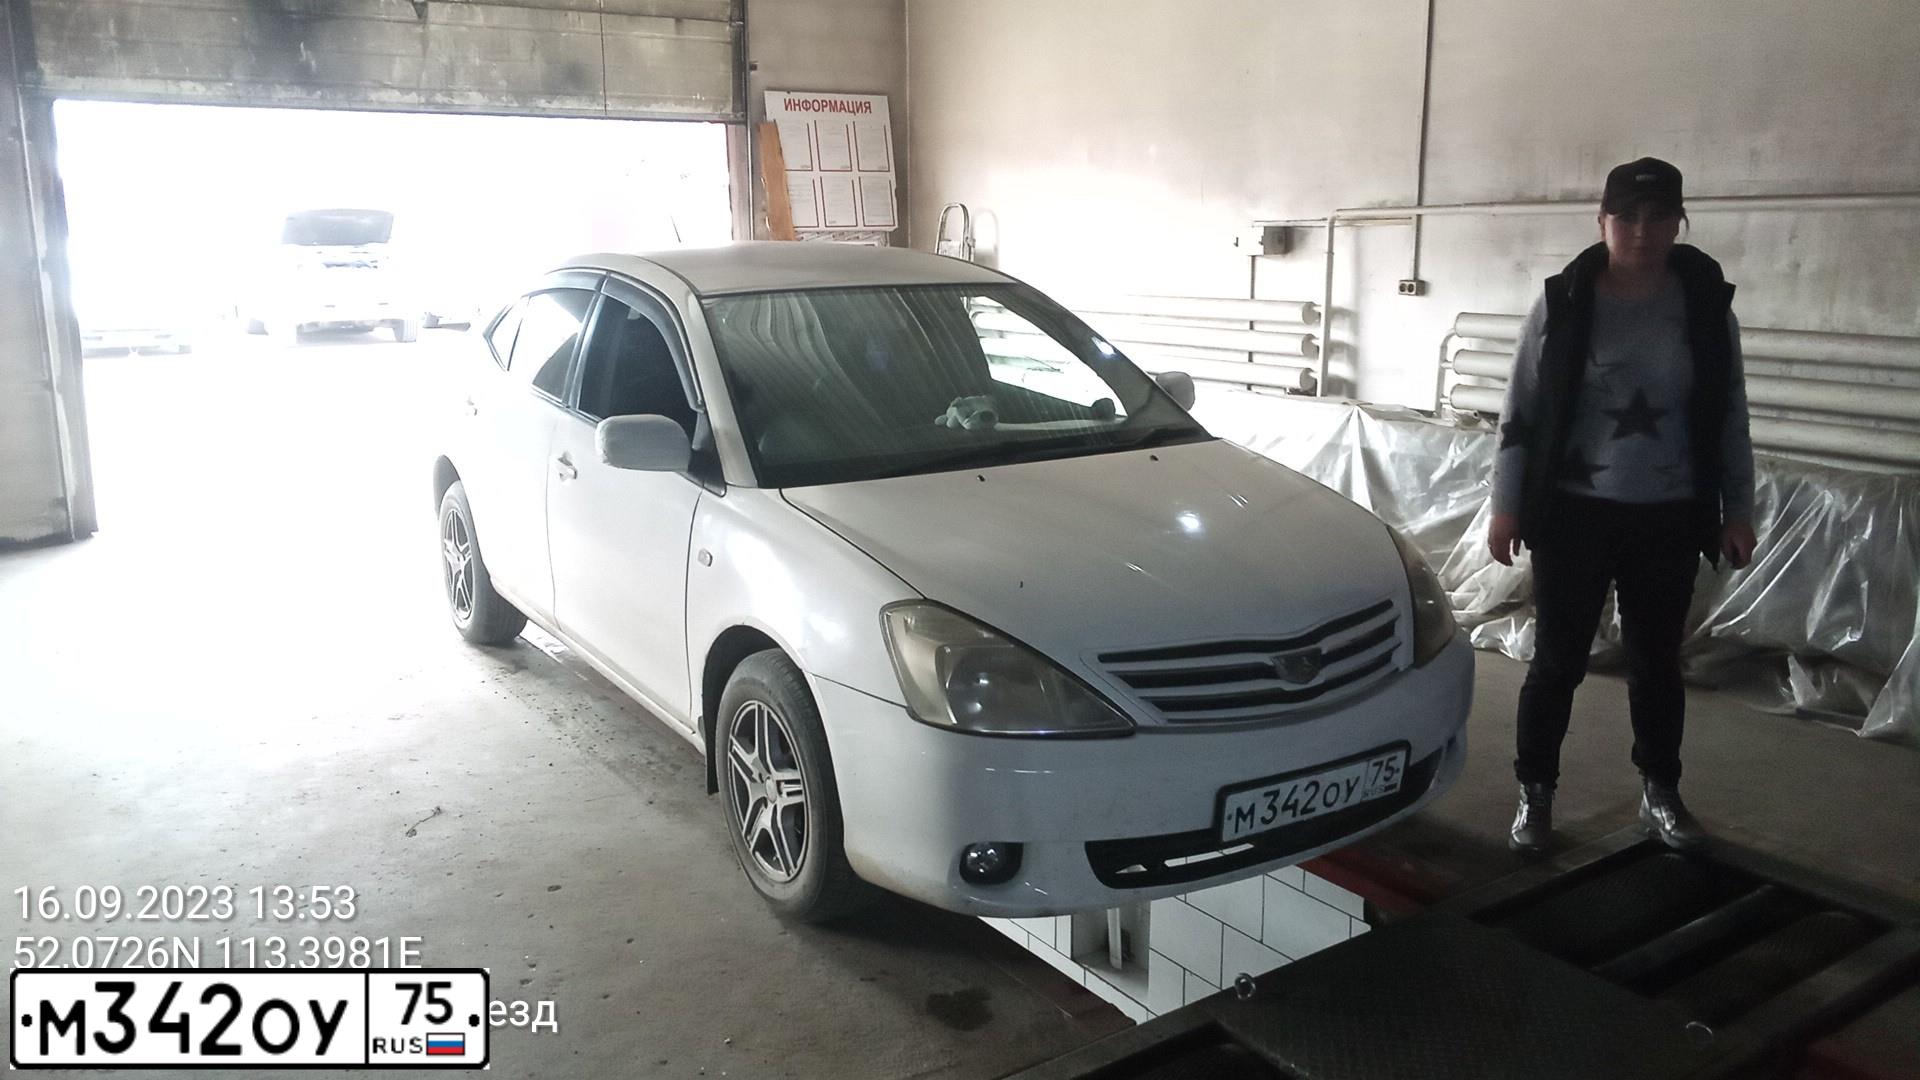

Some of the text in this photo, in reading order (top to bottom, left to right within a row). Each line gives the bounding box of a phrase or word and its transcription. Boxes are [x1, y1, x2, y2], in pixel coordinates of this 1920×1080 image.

[783, 98, 872, 115] ИНФОРМАЦИЯ
[1234, 755, 1398, 834] М342ОУ 75
